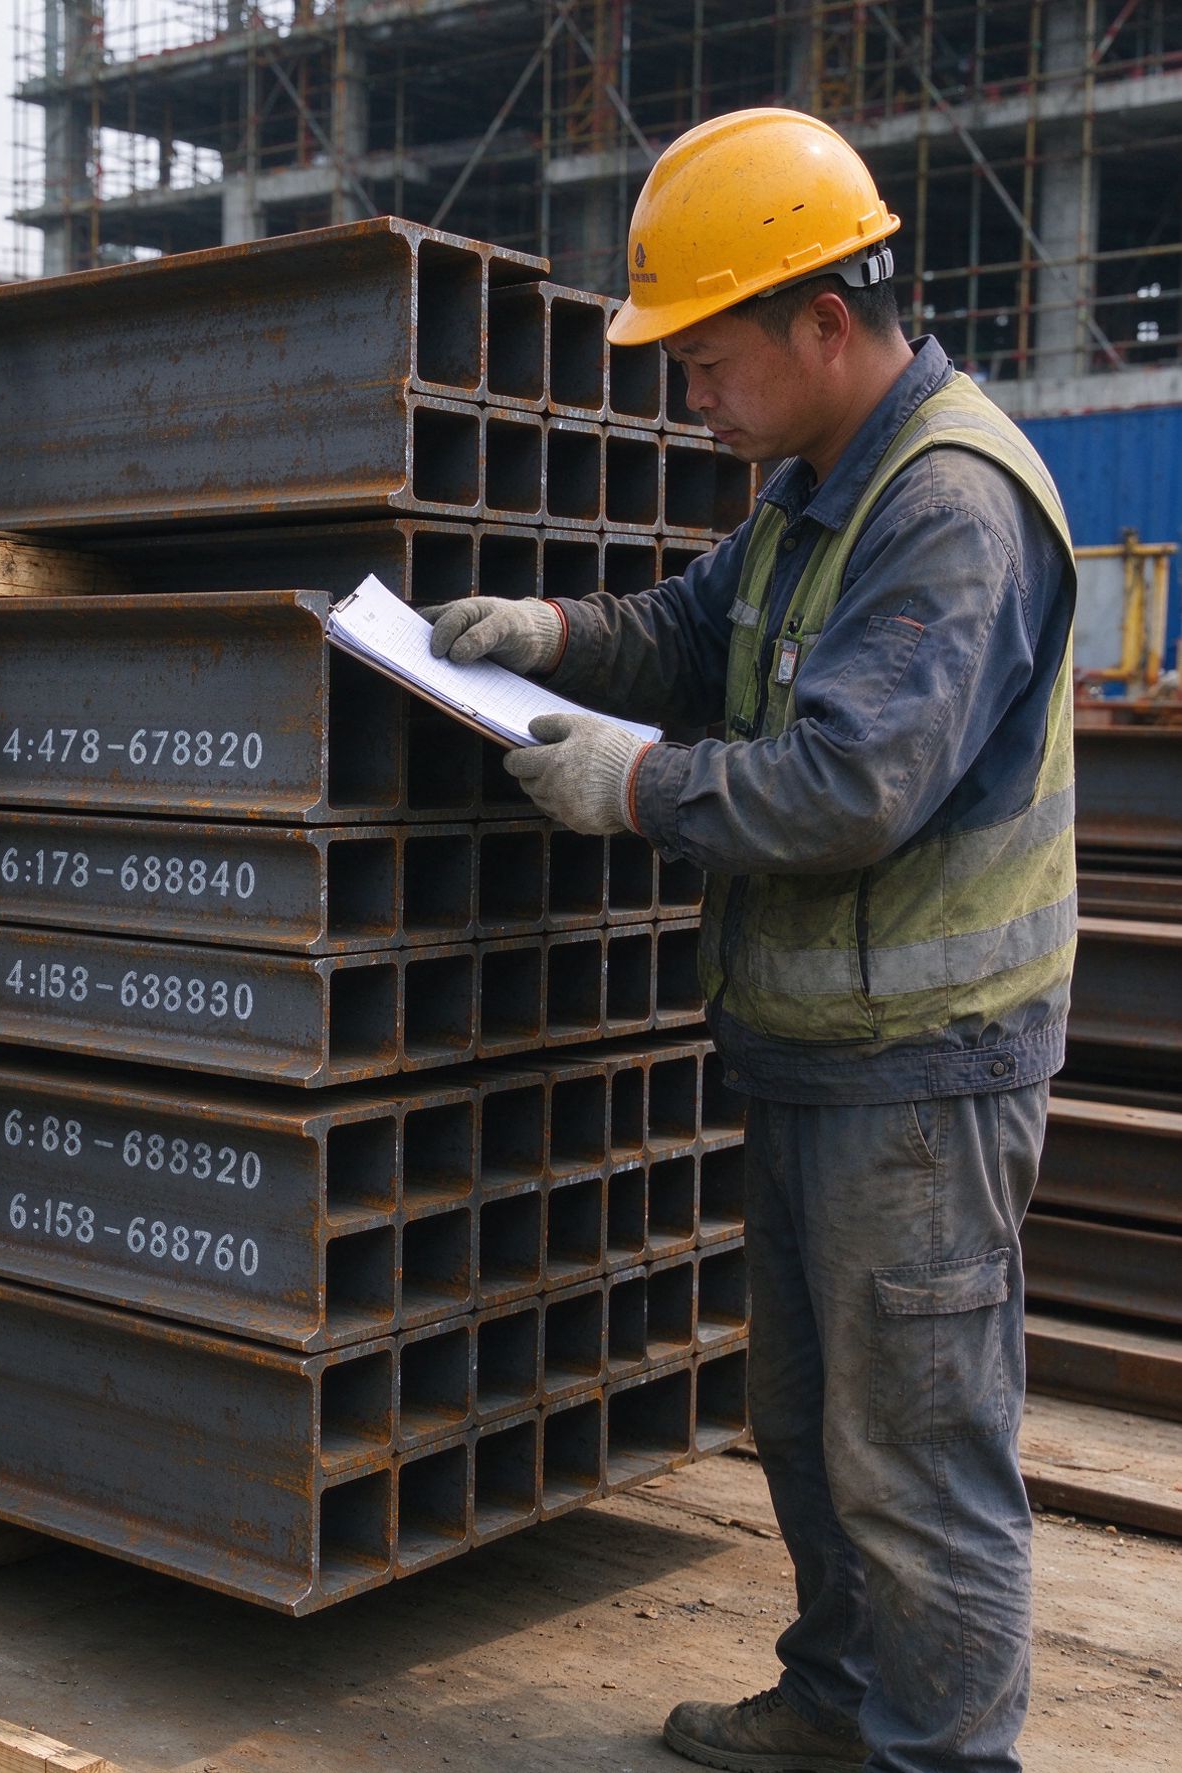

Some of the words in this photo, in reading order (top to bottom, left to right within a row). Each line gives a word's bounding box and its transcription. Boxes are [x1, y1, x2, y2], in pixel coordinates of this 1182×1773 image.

[2, 727, 264, 770] 4:478-678820
[0, 847, 256, 899] 6:178-688840
[9, 1192, 259, 1277] 6:158-688760
